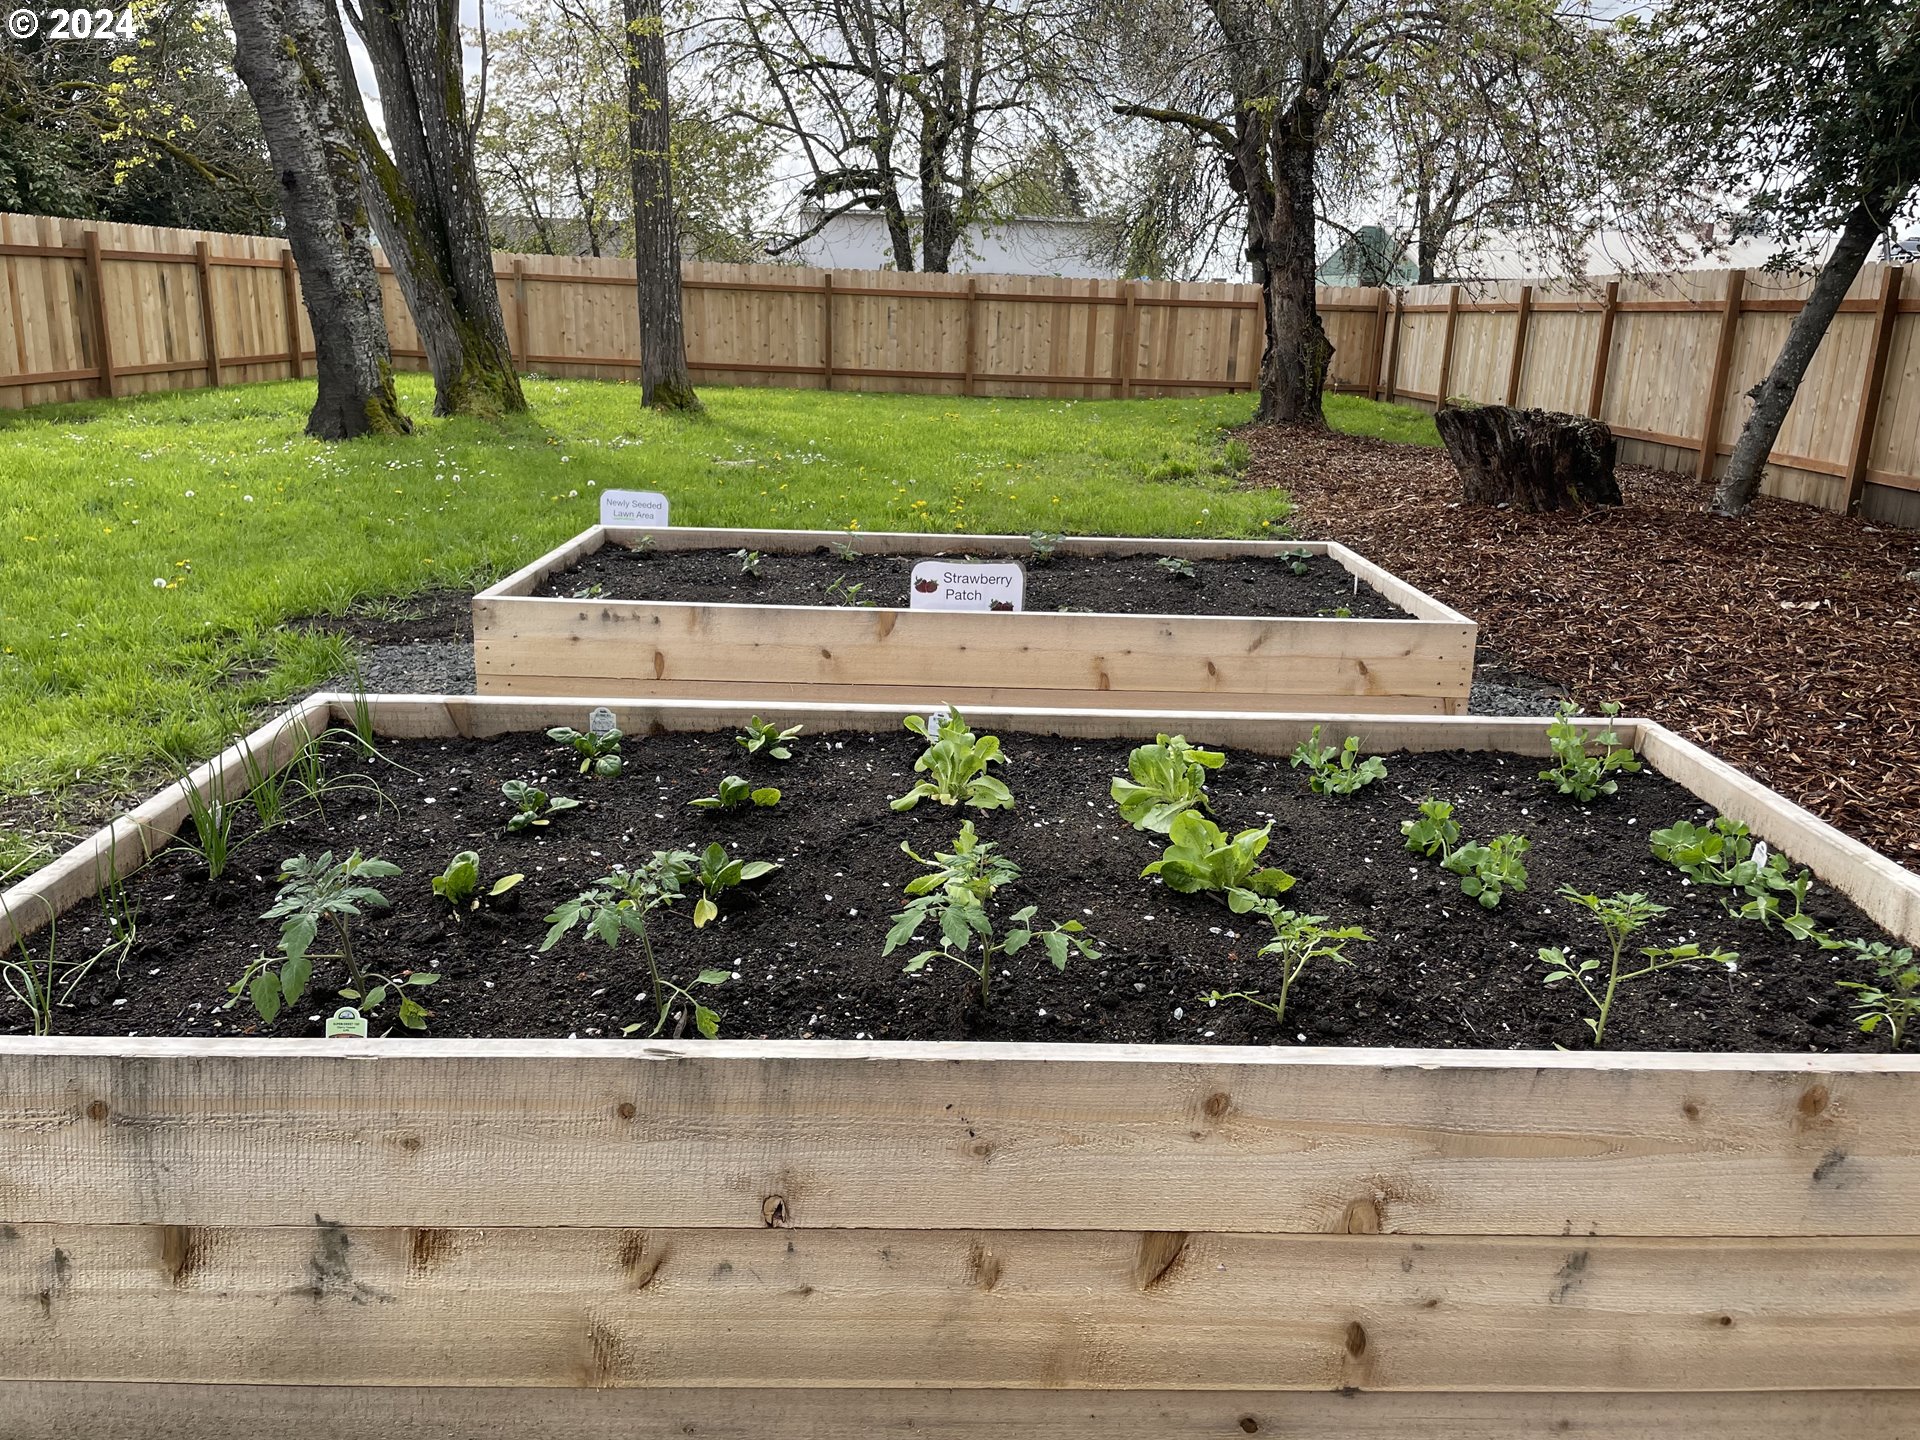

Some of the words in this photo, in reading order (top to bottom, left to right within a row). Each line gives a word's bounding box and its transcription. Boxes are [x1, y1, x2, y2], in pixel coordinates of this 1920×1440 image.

[606, 498, 630, 509] Newly
[632, 500, 662, 510] Seeded
[613, 510, 634, 518] Lawn
[636, 511, 655, 520] Area
[943, 571, 1013, 587] Strawberry
[946, 588, 982, 601] Patch
